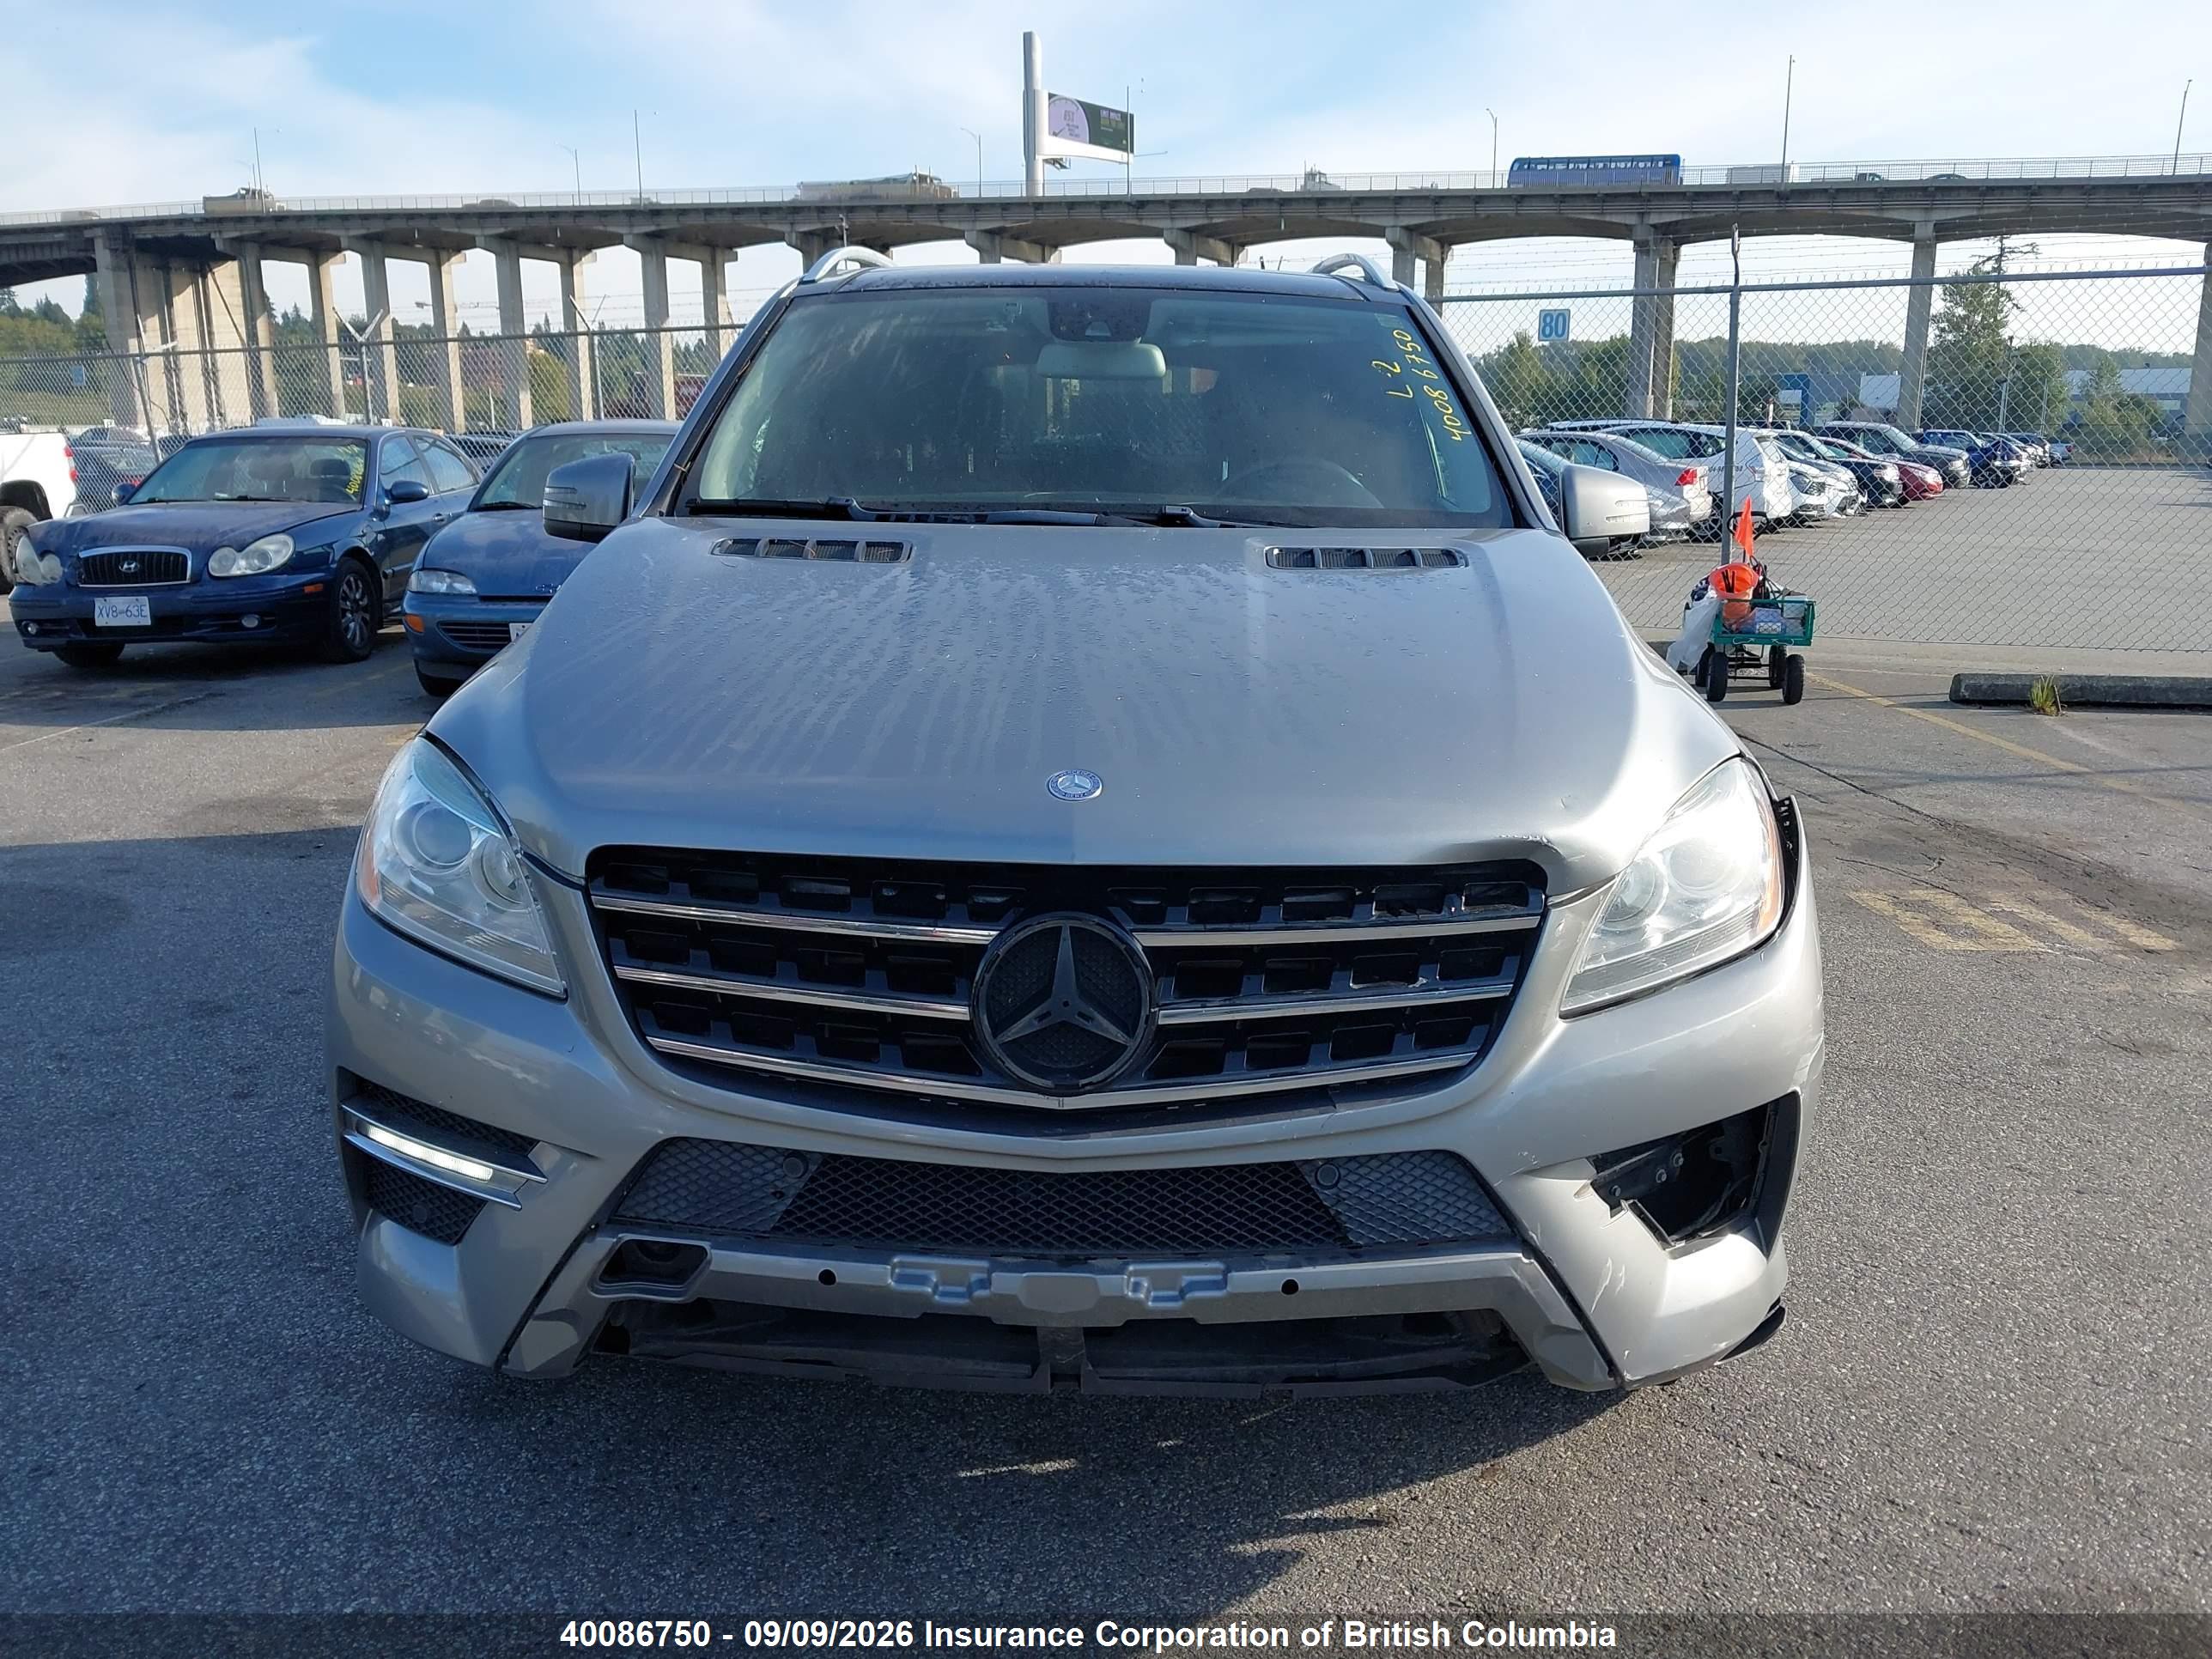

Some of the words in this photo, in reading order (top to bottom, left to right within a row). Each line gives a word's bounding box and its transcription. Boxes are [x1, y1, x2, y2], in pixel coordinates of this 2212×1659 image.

[1541, 313, 1567, 338] 80
[1393, 329, 1472, 441] 40086750
[97, 604, 148, 618] XV8-63E
